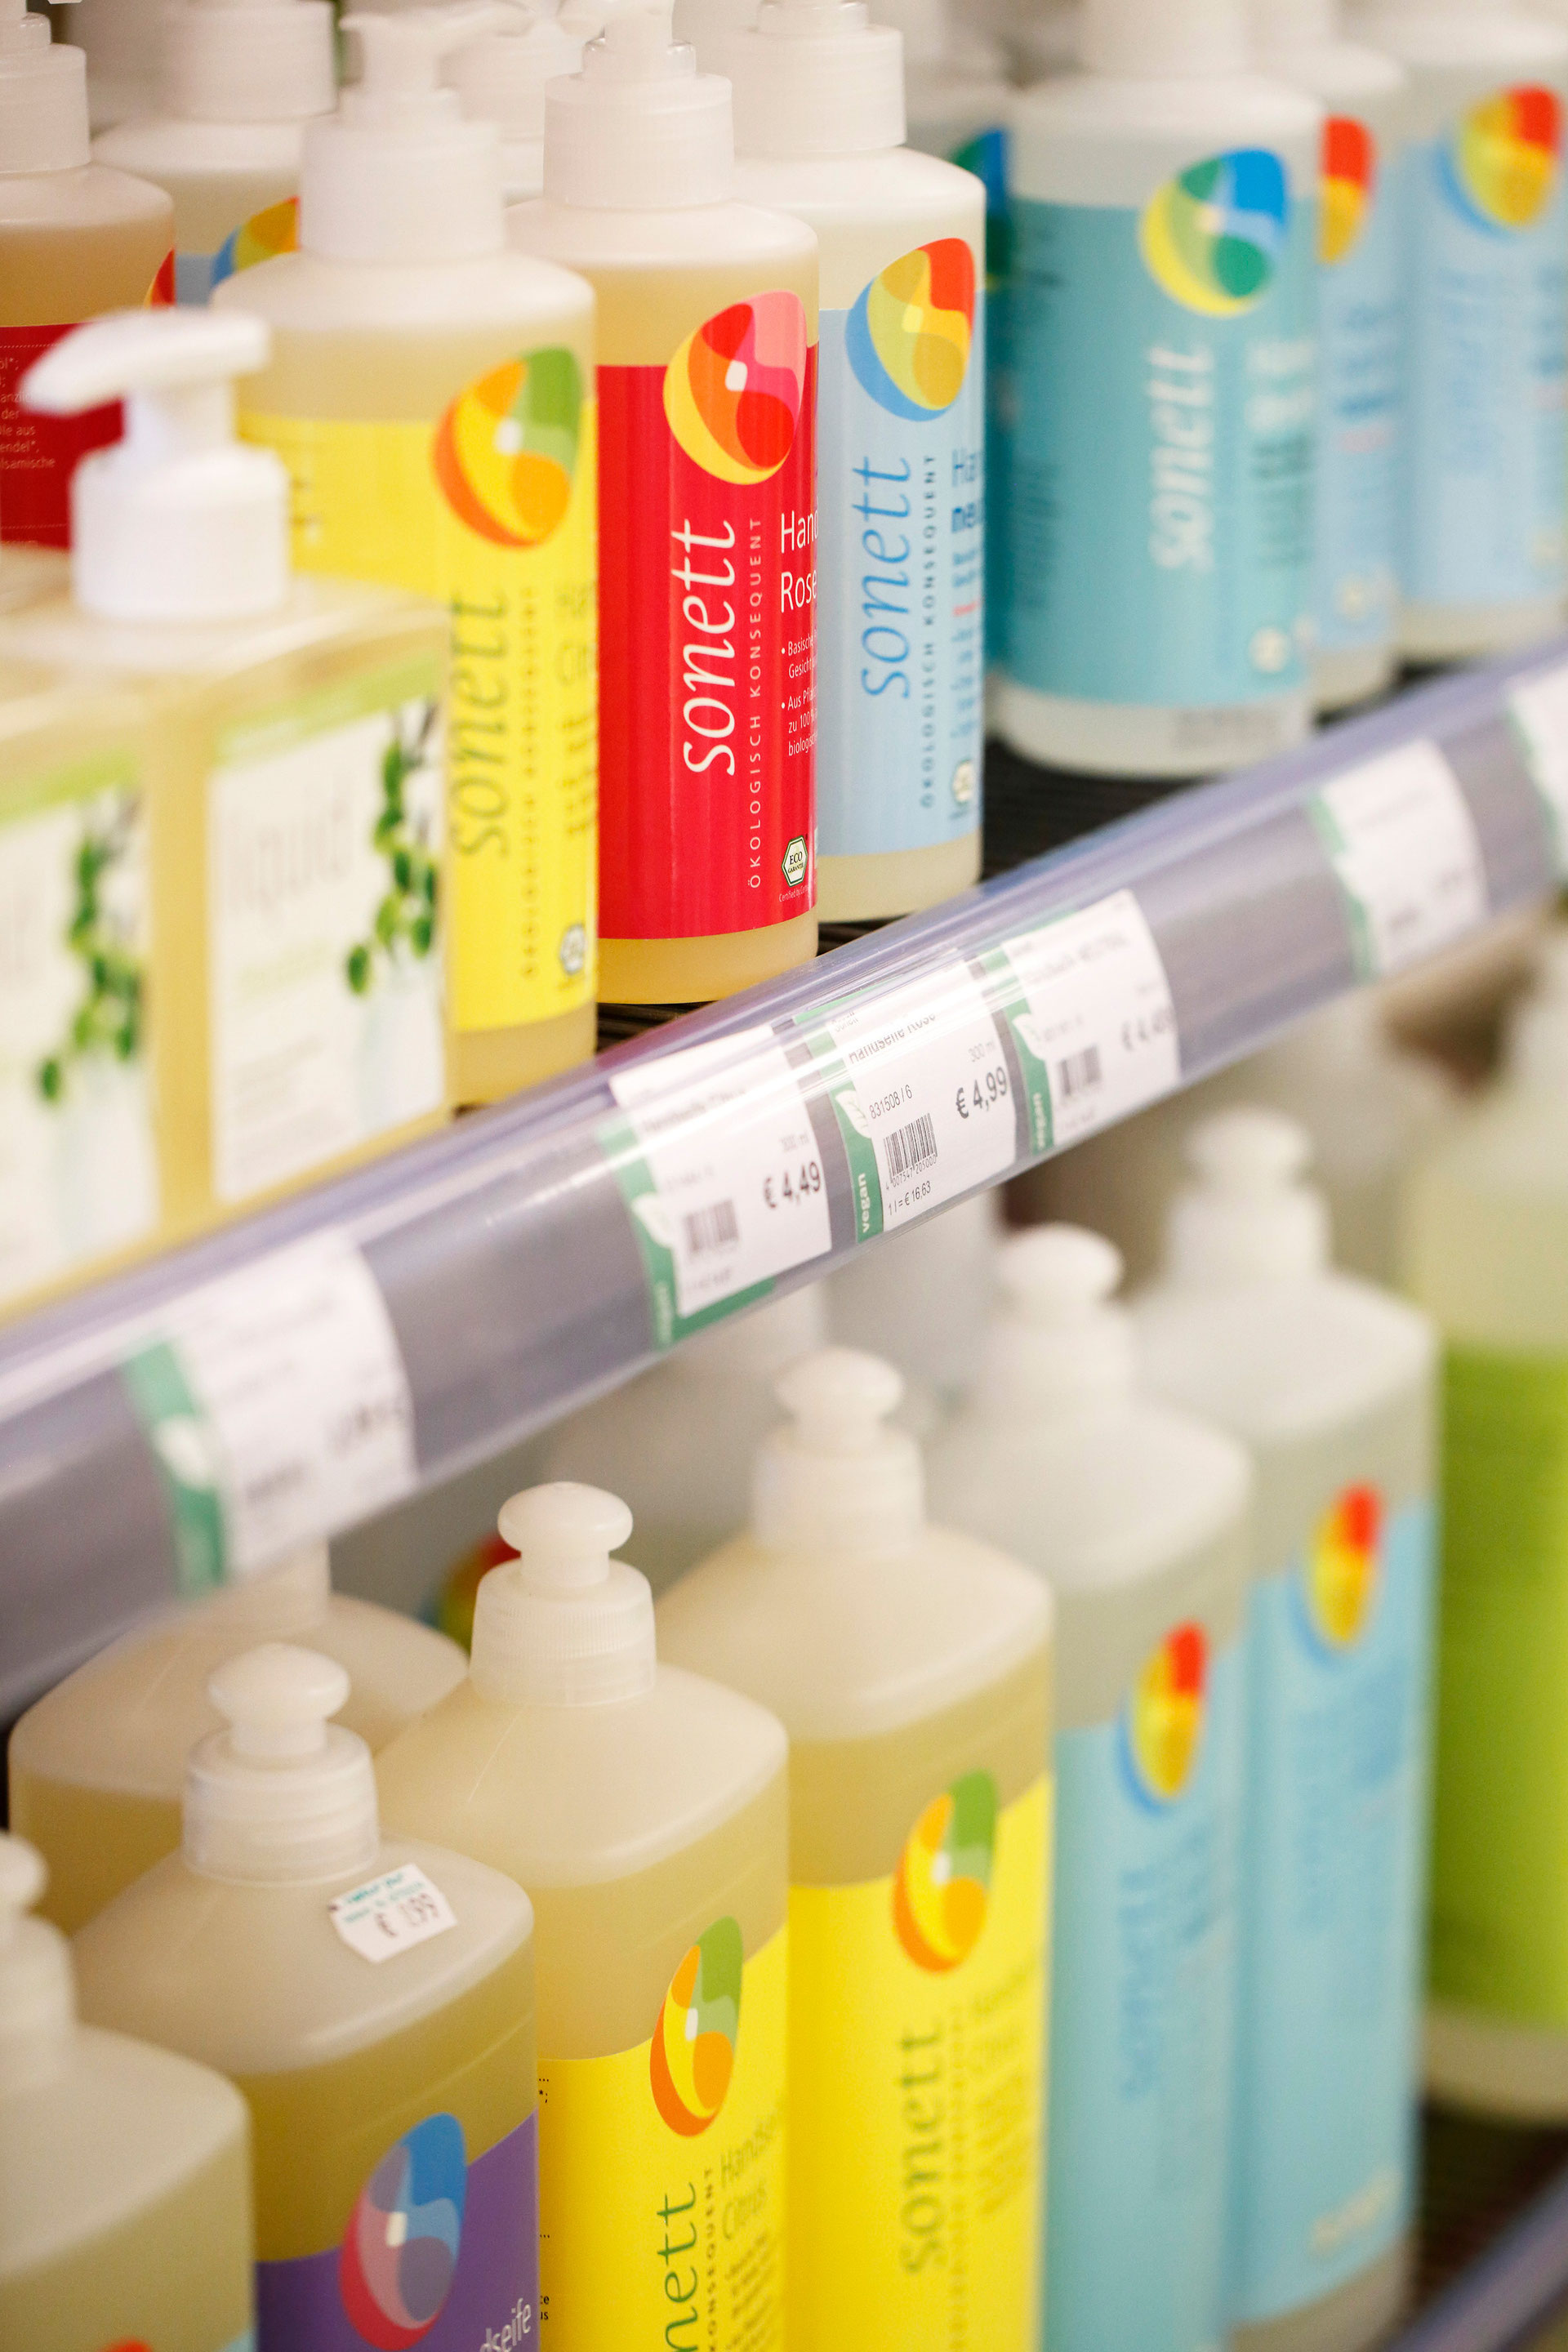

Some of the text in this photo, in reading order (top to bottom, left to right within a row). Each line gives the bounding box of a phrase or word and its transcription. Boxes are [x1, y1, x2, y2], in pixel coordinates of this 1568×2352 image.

[781, 568, 817, 613] Rose
[852, 455, 911, 701] sonett
[670, 518, 736, 776] sonett
[789, 657, 812, 679] Gesicht
[747, 518, 763, 889] ÖKOLOGISCH KONSEQUENT
[787, 695, 802, 711] Aus
[788, 720, 798, 734] zu
[800, 710, 810, 729] 100
[790, 851, 803, 866] ECO
[956, 1067, 1009, 1120] € 4,99
[764, 1175, 777, 1209] €
[783, 1160, 822, 1207] 4,49
[858, 1173, 871, 1234] vegan
[911, 1180, 931, 1202] 16,63
